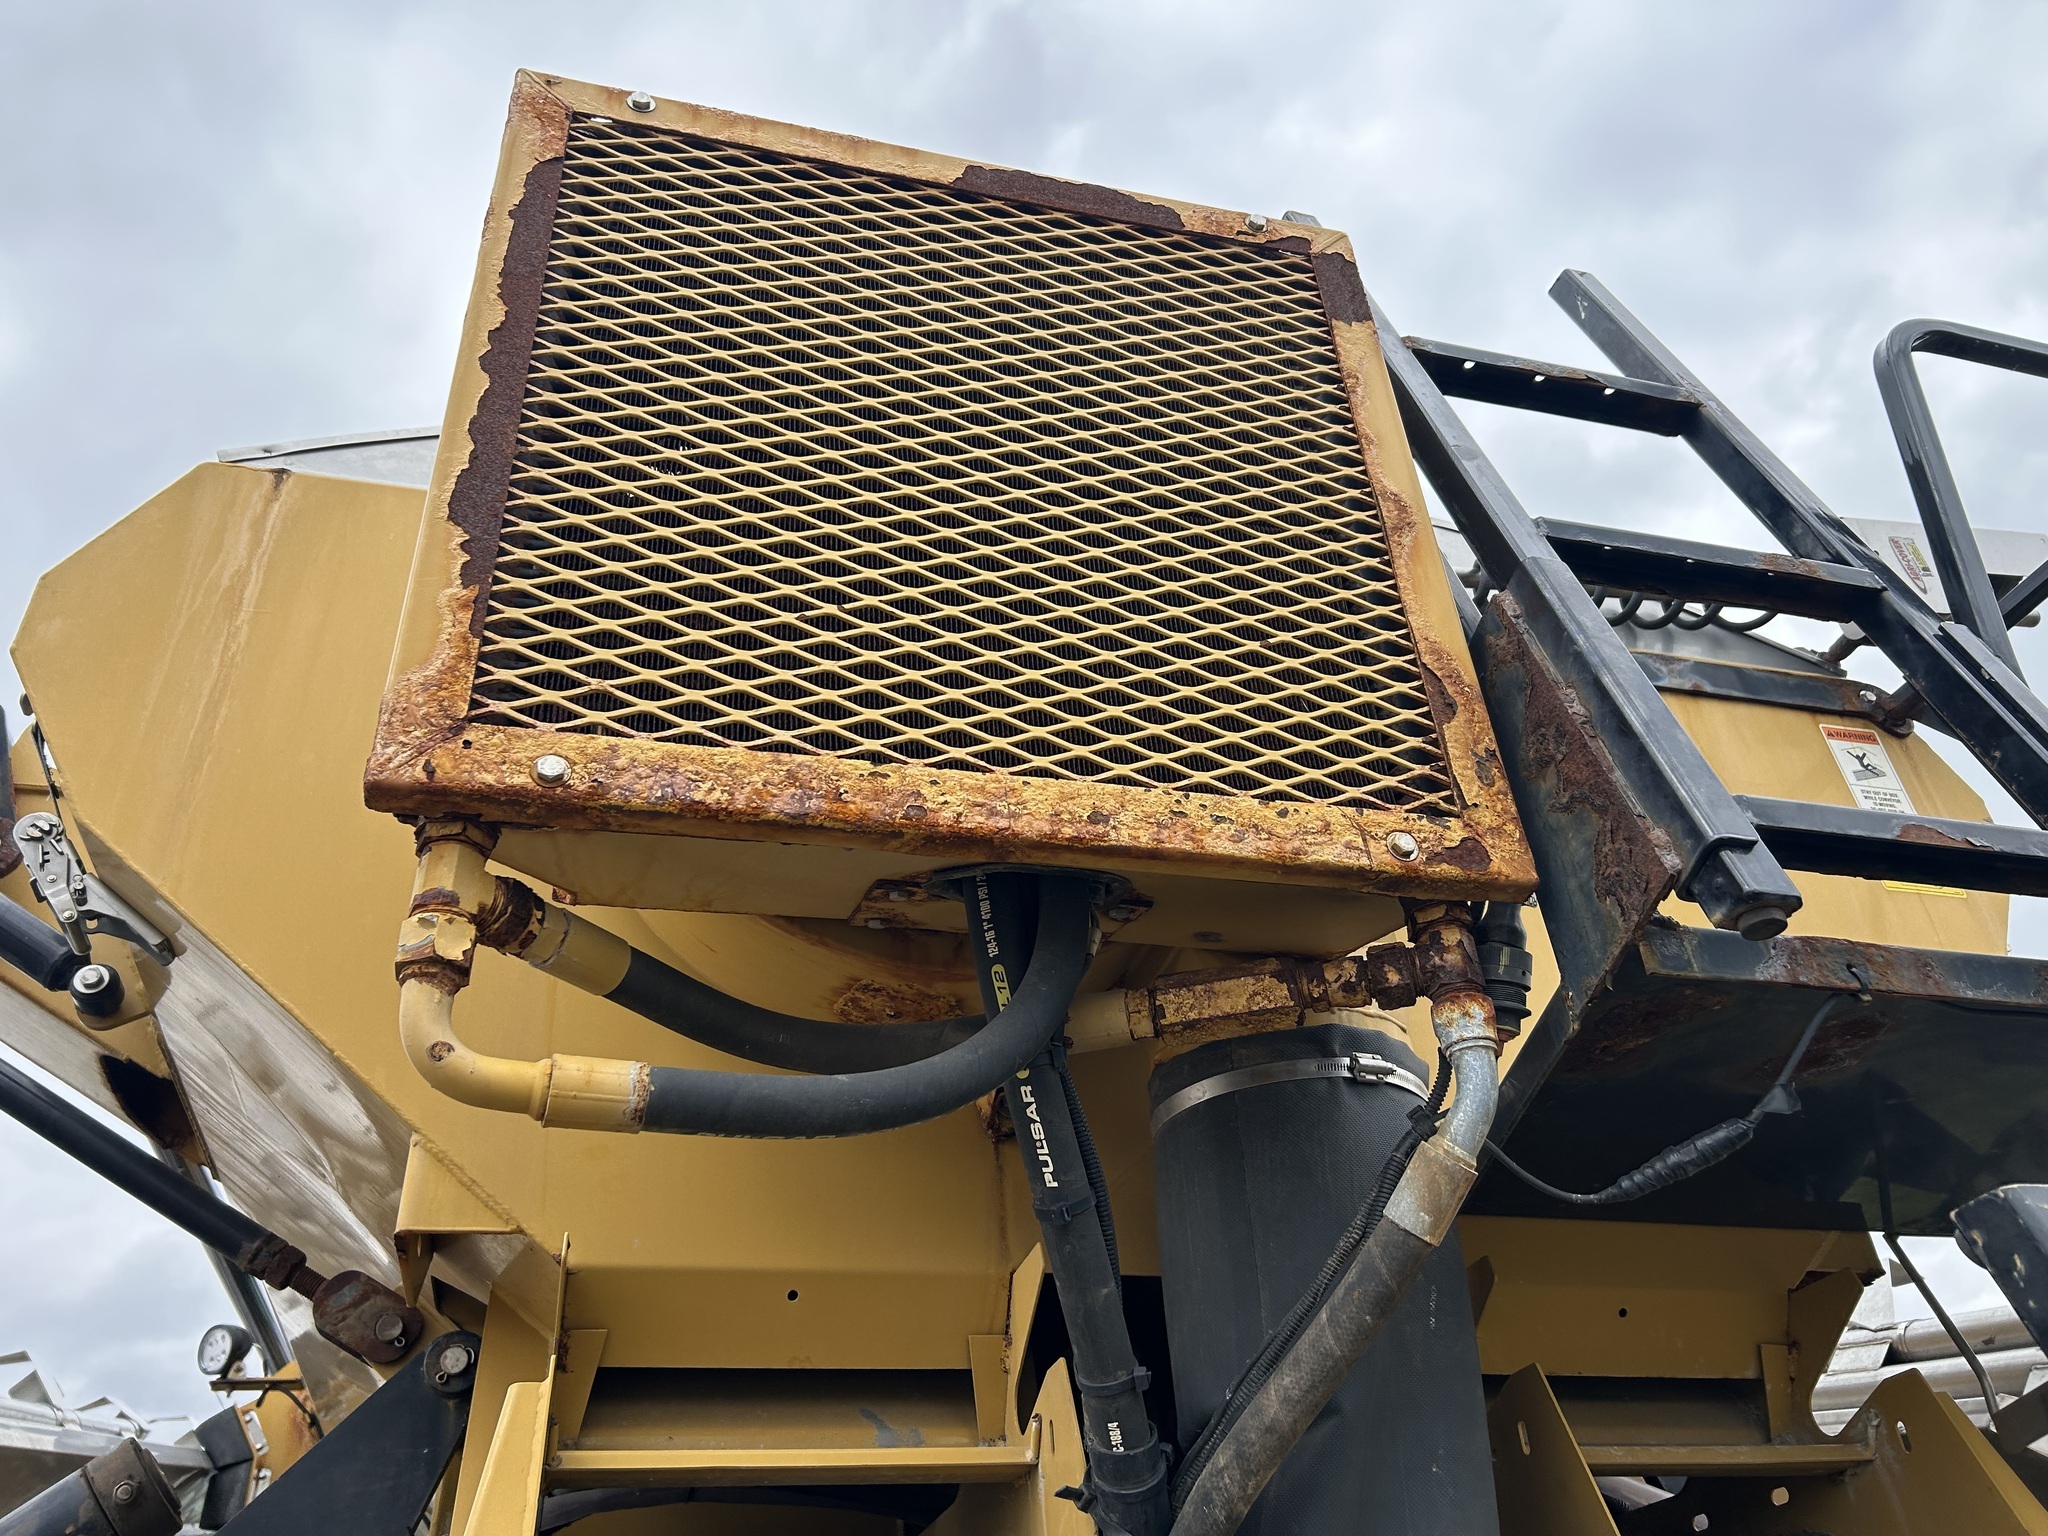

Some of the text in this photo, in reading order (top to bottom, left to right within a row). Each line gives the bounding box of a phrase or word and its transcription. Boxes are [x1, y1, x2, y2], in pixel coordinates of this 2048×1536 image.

[1833, 731, 1875, 741] WARNING
[977, 886, 989, 900] PSI
[979, 900, 992, 920] 4100
[984, 929, 999, 958] 124-16
[993, 970, 1007, 994] 12
